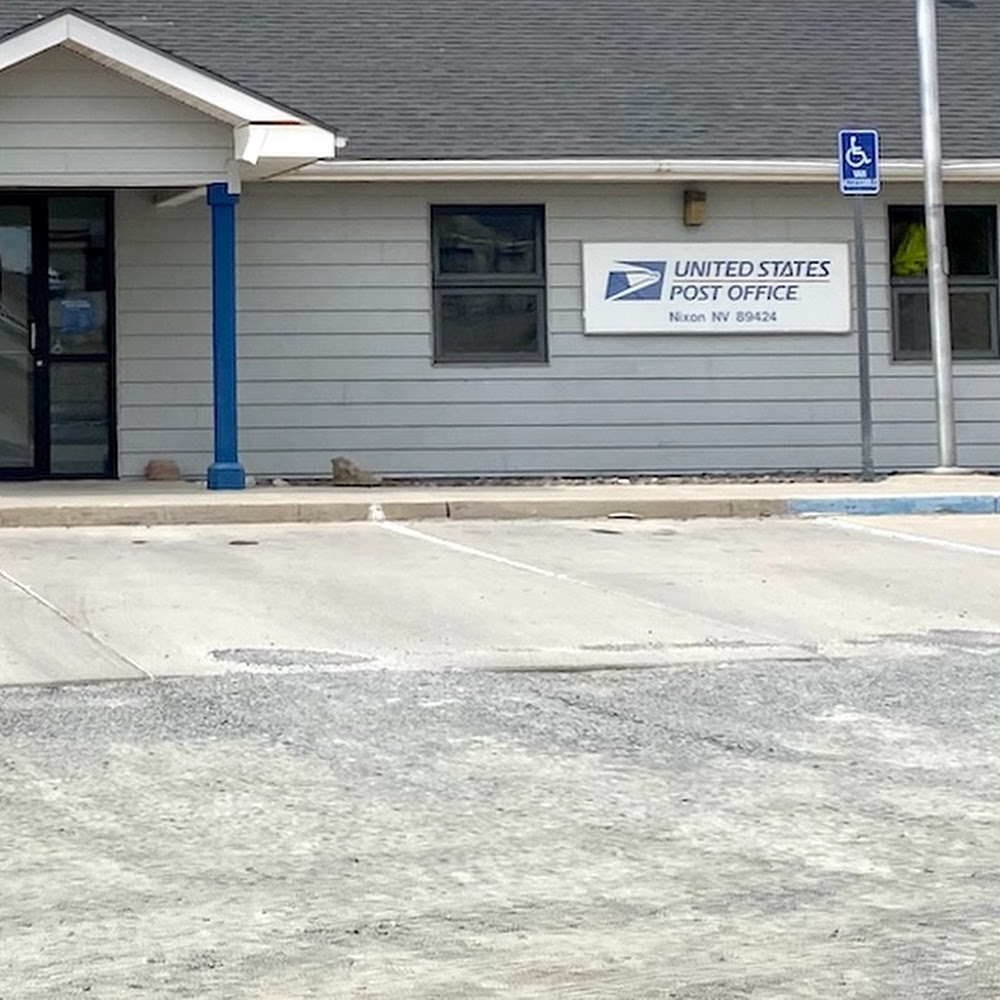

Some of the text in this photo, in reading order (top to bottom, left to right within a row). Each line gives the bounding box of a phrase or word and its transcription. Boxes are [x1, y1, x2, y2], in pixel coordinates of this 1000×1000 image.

[674, 261, 831, 278] UNITED STATES
[670, 285, 799, 301] POST OFFICE
[669, 311, 777, 323] Nixon NV 89424
